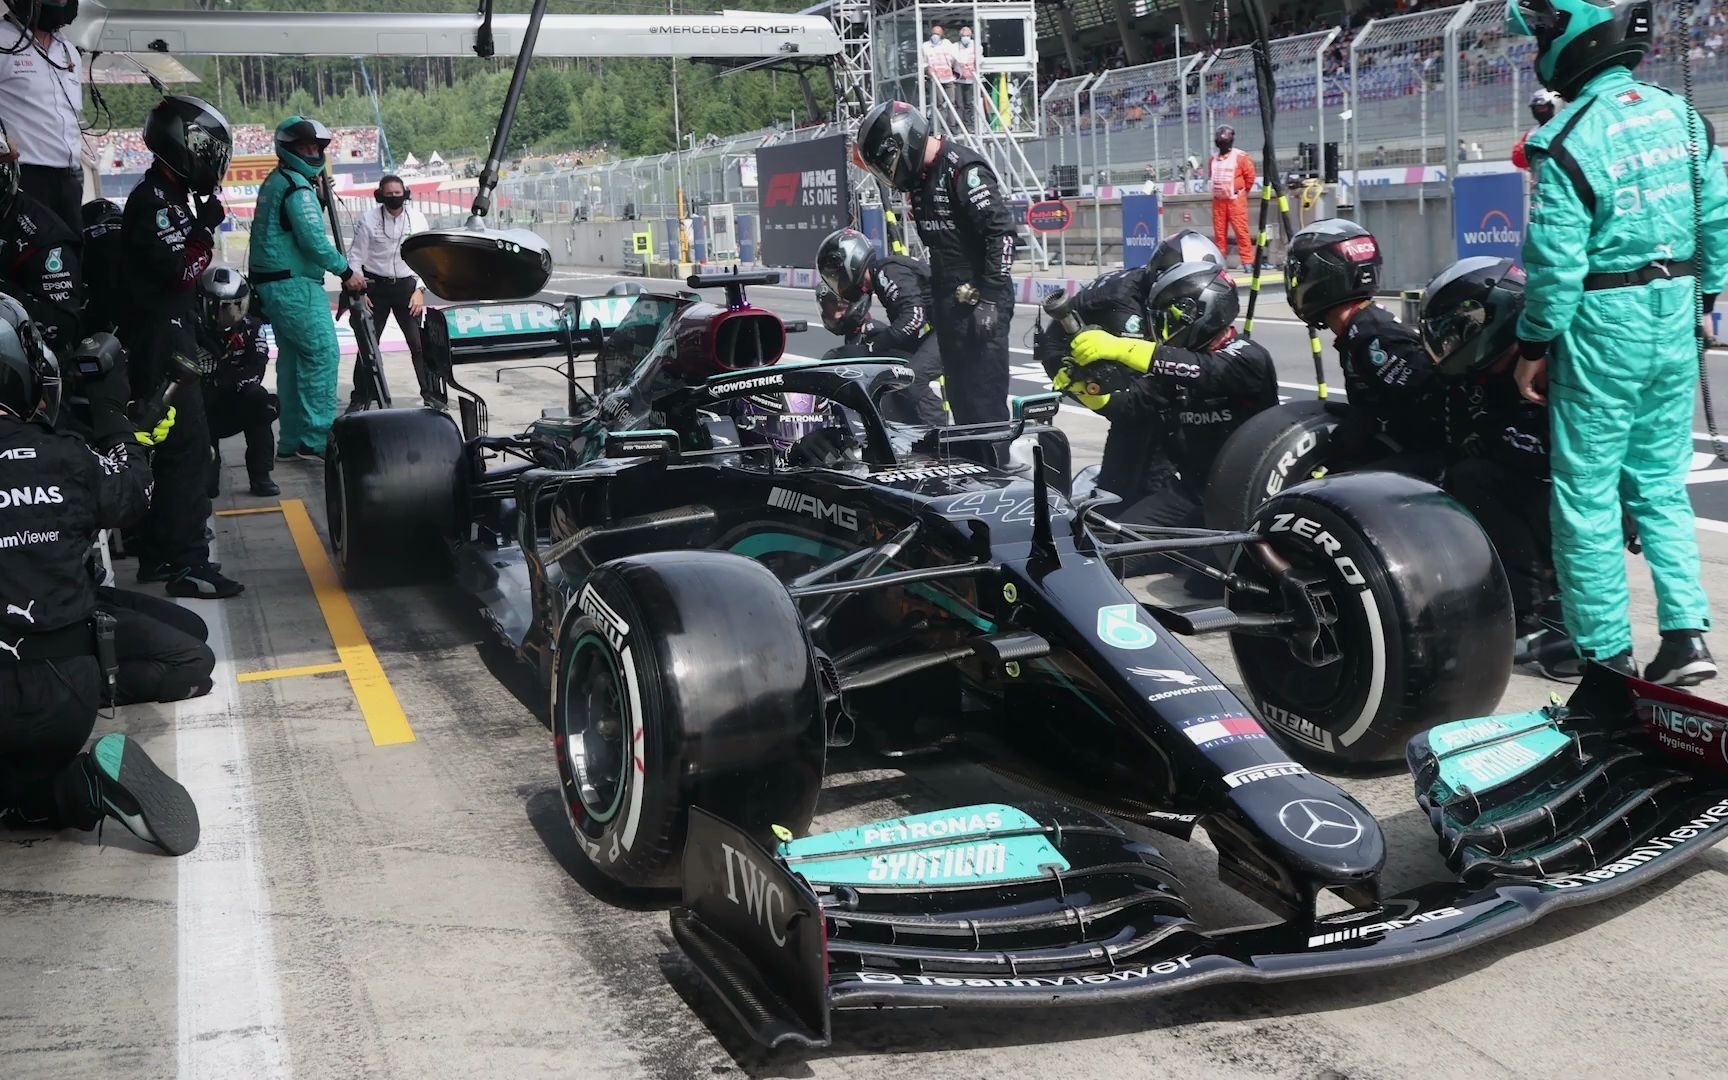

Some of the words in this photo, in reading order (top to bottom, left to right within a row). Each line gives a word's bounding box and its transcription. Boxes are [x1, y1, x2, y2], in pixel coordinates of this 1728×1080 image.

[802, 189, 815, 206] AS
[816, 188, 838, 205] ONE
[42, 280, 73, 291] EPSON
[712, 374, 784, 395] CROWDSTRIKE
[780, 414, 824, 423] PETRONAS
[796, 493, 858, 532] AMG
[947, 488, 1069, 527] 44
[1270, 513, 1366, 585] ZERO
[577, 582, 630, 653] PIRELLI
[1184, 711, 1244, 726] TOMMY
[1652, 704, 1713, 743] INEOS
[1659, 731, 1705, 756] Hygienics
[864, 812, 1002, 845] PETRONAS
[721, 842, 787, 948] IWC
[1358, 906, 1465, 937] AMG
[903, 953, 1192, 987] TeamViewer
